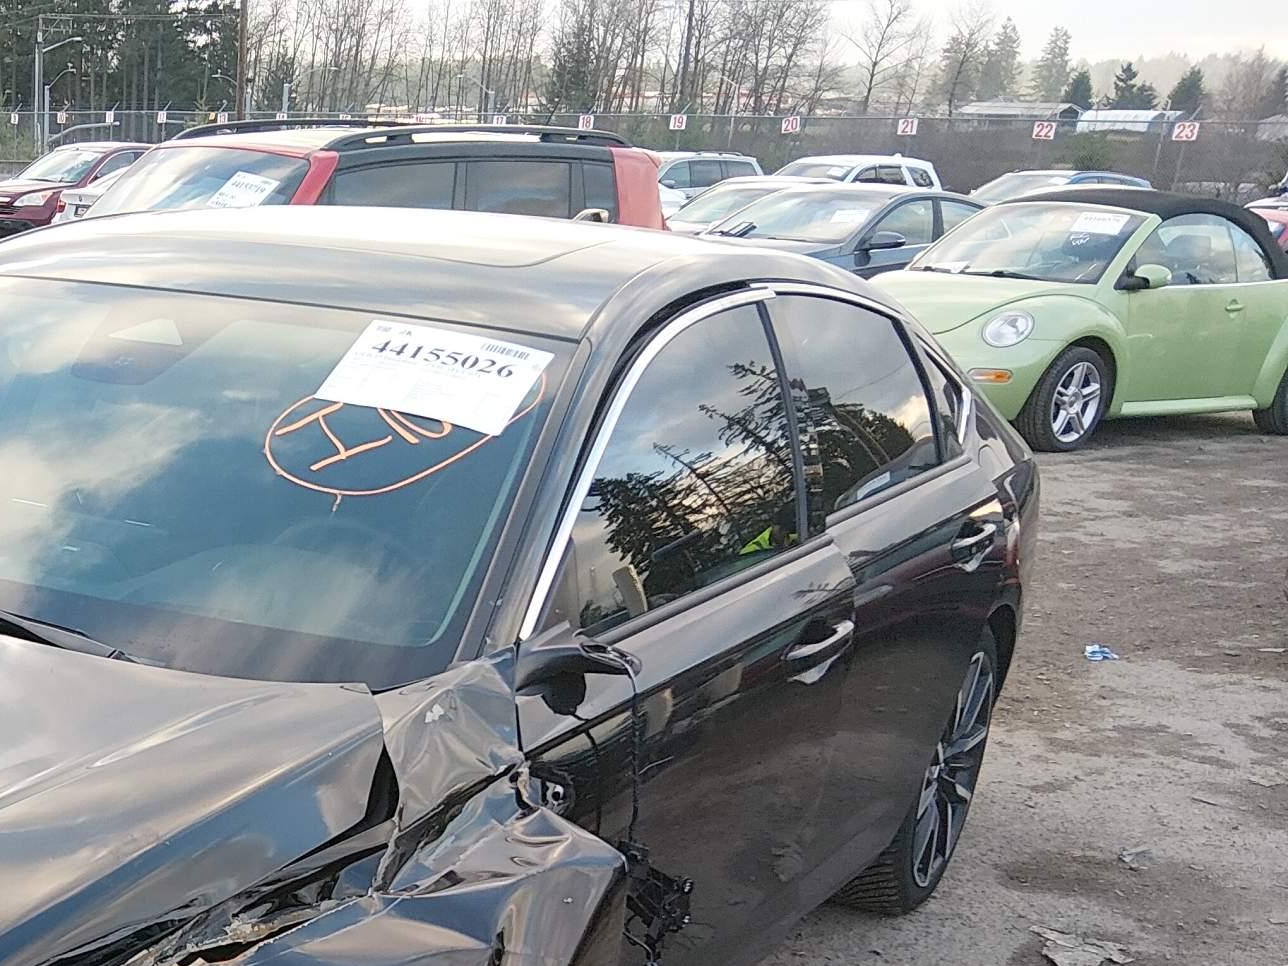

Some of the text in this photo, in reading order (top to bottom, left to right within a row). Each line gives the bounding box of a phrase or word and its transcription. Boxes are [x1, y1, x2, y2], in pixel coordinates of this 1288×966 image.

[495, 116, 504, 124] 17
[581, 117, 591, 128] 18
[671, 116, 684, 129] 19
[783, 118, 798, 131] 20
[901, 119, 914, 133] 21
[1034, 123, 1053, 138] 22
[1174, 123, 1196, 139] 23
[371, 339, 516, 379] 44155026
